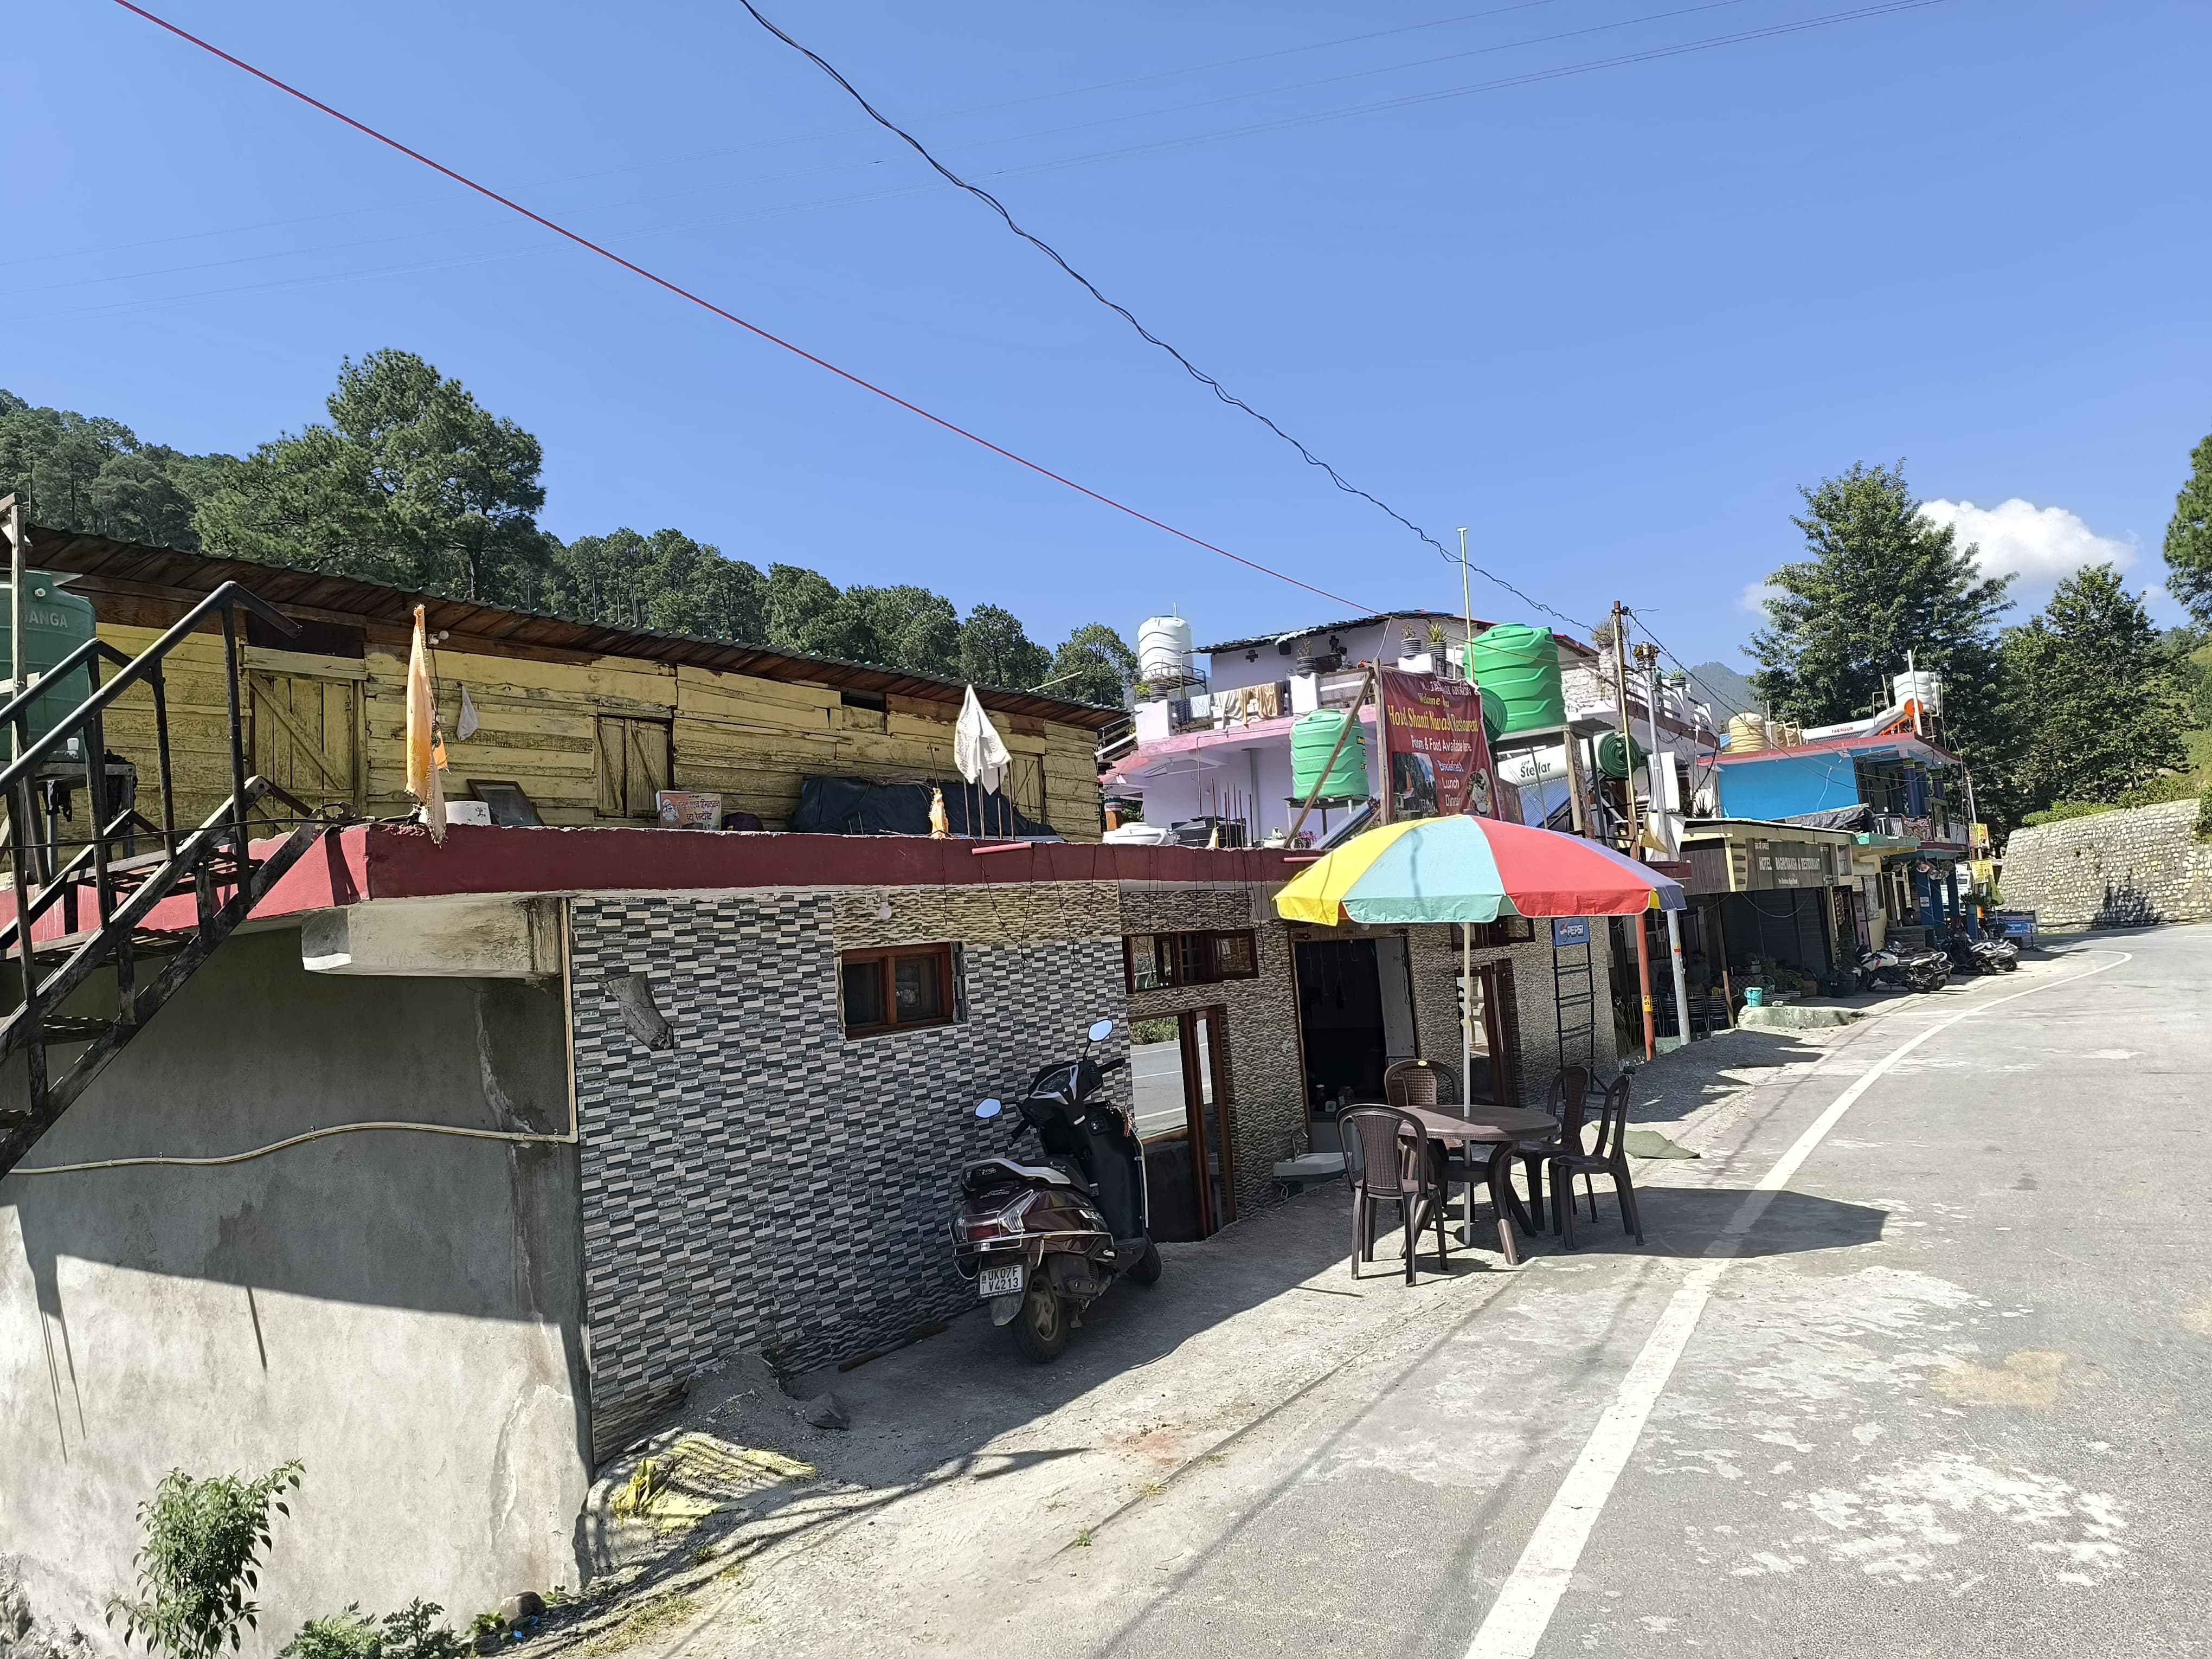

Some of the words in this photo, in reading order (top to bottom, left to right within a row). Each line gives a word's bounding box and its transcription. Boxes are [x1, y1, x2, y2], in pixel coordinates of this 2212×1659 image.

[26, 610, 68, 628] ANGA
[1418, 692, 1441, 705] Welcome
[1408, 708, 1430, 729] Shanti
[1424, 737, 1429, 749] &
[1429, 737, 1442, 751] Food
[1442, 739, 1463, 752] Available
[1520, 762, 1551, 778] Stelar
[1442, 776, 1459, 789] Lunch
[1445, 794, 1461, 807] Dinner
[1758, 857, 1772, 871] HOTEL
[1567, 924, 1584, 936] PEPSI
[988, 1266, 1019, 1281] UK07F
[989, 1277, 1019, 1291] V4213
